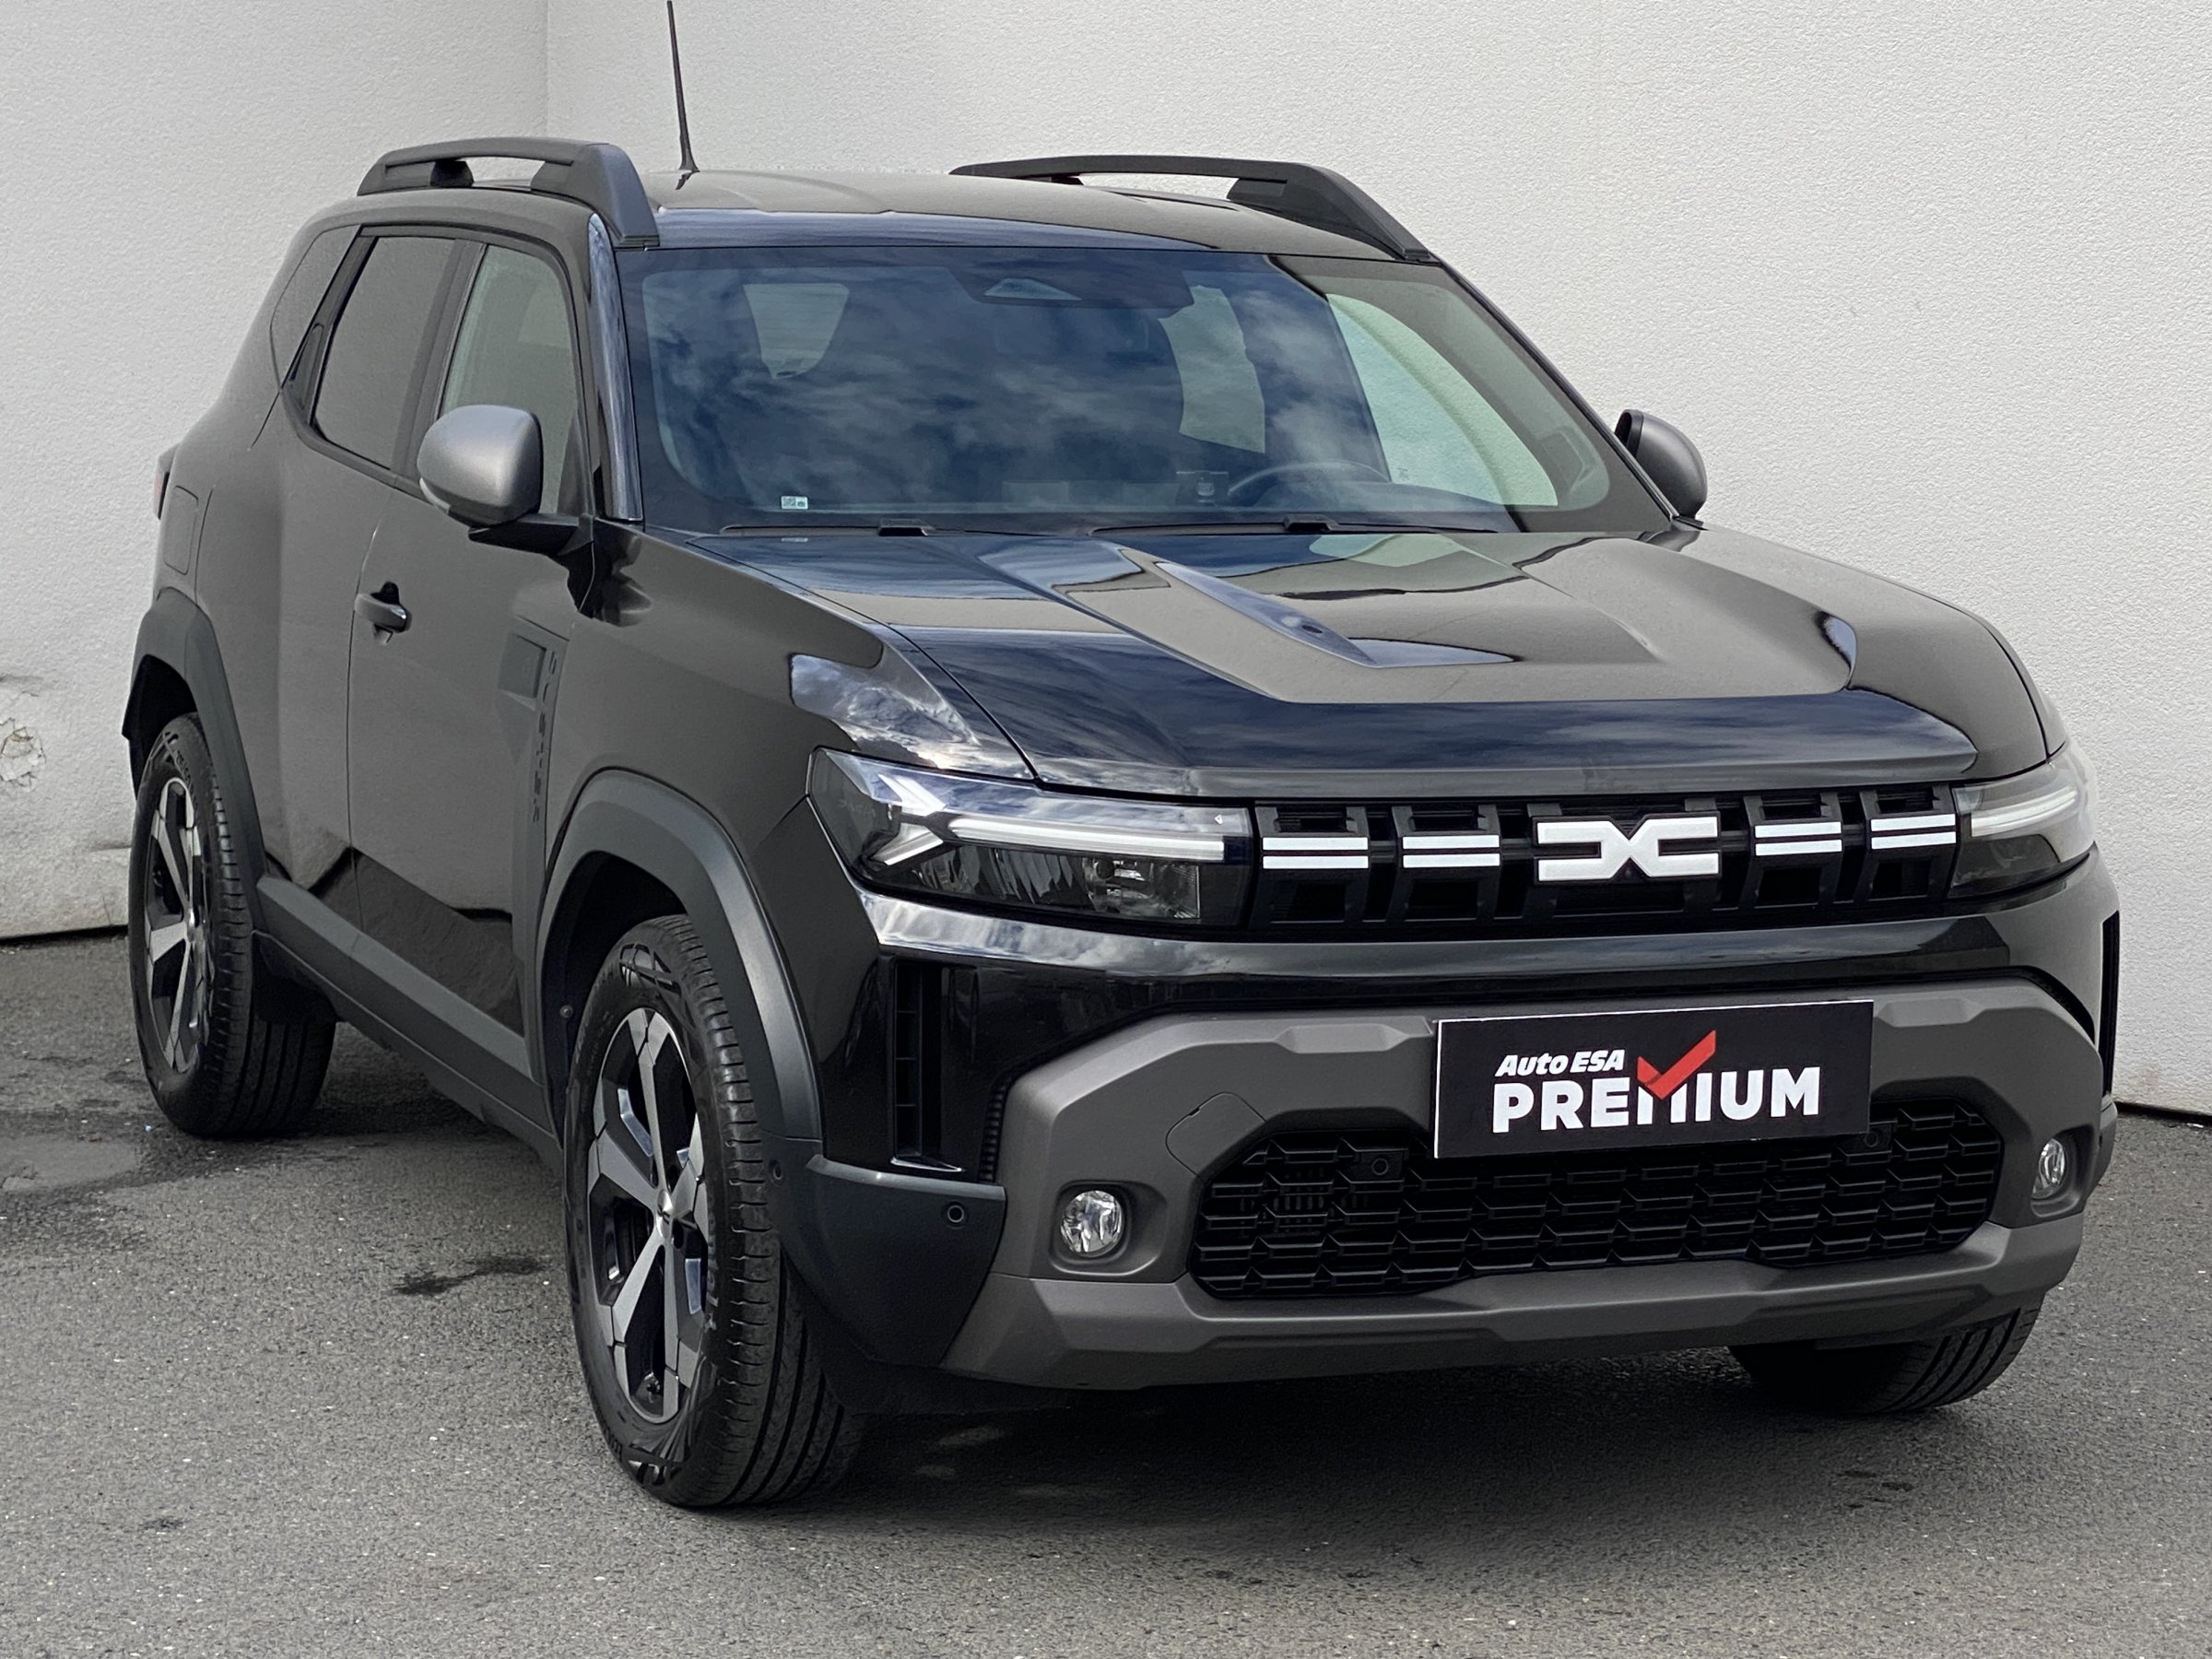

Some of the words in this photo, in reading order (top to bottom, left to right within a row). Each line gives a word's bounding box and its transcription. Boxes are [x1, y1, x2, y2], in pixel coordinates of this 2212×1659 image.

[1494, 1053, 1570, 1077] Auto
[1569, 1049, 1626, 1074] ESA
[1492, 1066, 1820, 1134] PREMIUM
